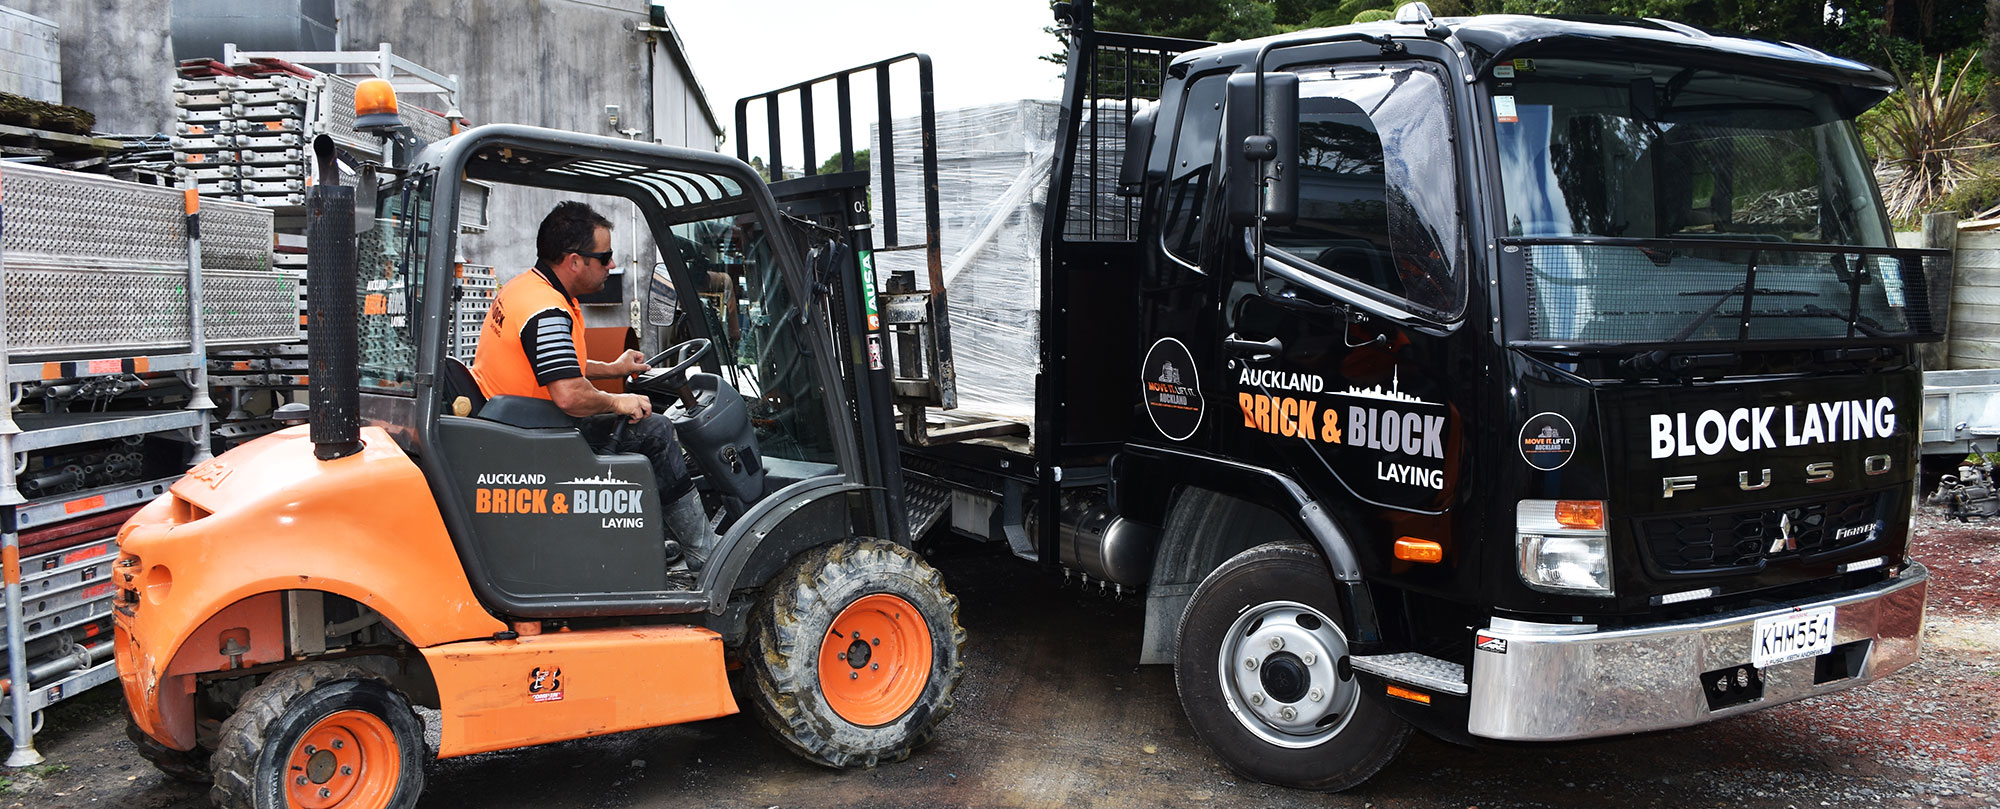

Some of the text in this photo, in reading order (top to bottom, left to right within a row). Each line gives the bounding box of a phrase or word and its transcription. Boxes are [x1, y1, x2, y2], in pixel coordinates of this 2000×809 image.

[862, 253, 878, 311] AUSA
[1239, 368, 1324, 393] AUCKLAND
[1239, 392, 1446, 459] BRICK & BLOCK
[1650, 396, 1896, 459] BLOCK LAYING
[476, 473, 547, 485] AUCKLAND
[1377, 460, 1444, 490] LAYING
[1662, 453, 1892, 499] FUSO
[475, 488, 643, 514] BRICK & BLOCK
[601, 517, 644, 529] LAYING
[1761, 617, 1828, 656] KHM554
